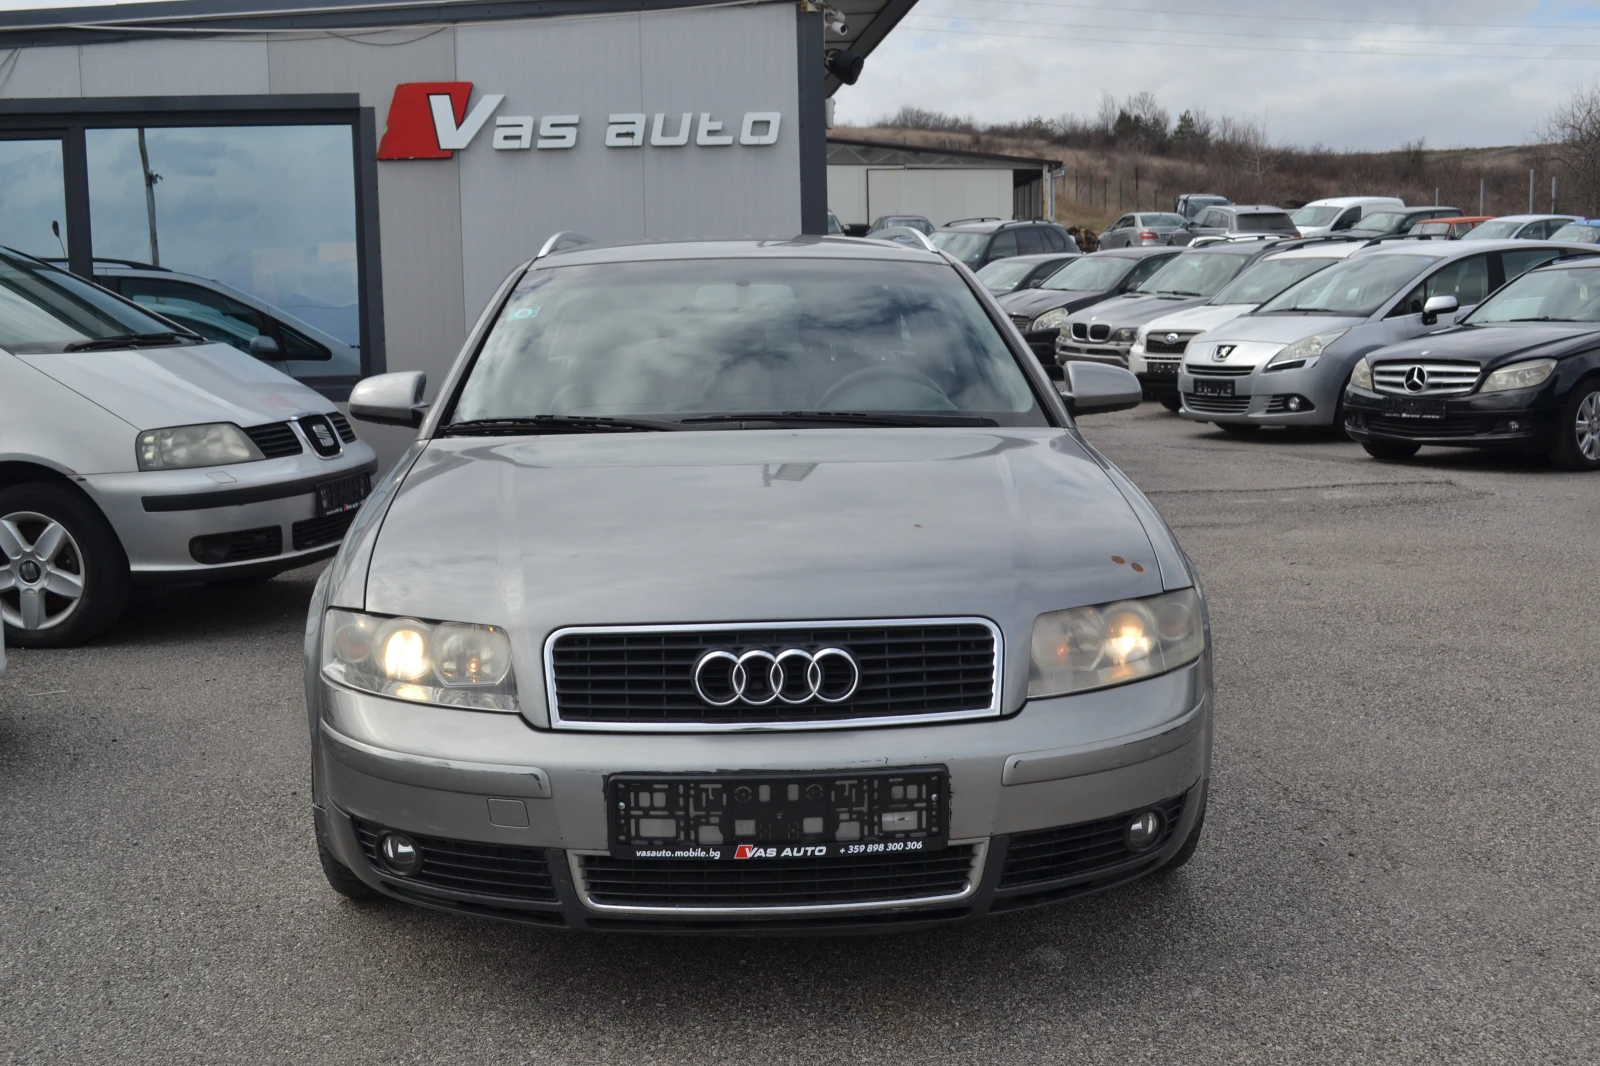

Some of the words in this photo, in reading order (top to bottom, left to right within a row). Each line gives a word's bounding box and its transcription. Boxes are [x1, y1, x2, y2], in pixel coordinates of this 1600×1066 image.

[428, 94, 580, 150] Vas
[605, 112, 781, 147] auto
[636, 848, 721, 859] vasauto.mobile.bg
[745, 847, 777, 858] VAS
[780, 846, 827, 857] AUTO
[867, 843, 884, 852] 898
[886, 842, 903, 851] 300
[905, 841, 923, 850] 306
